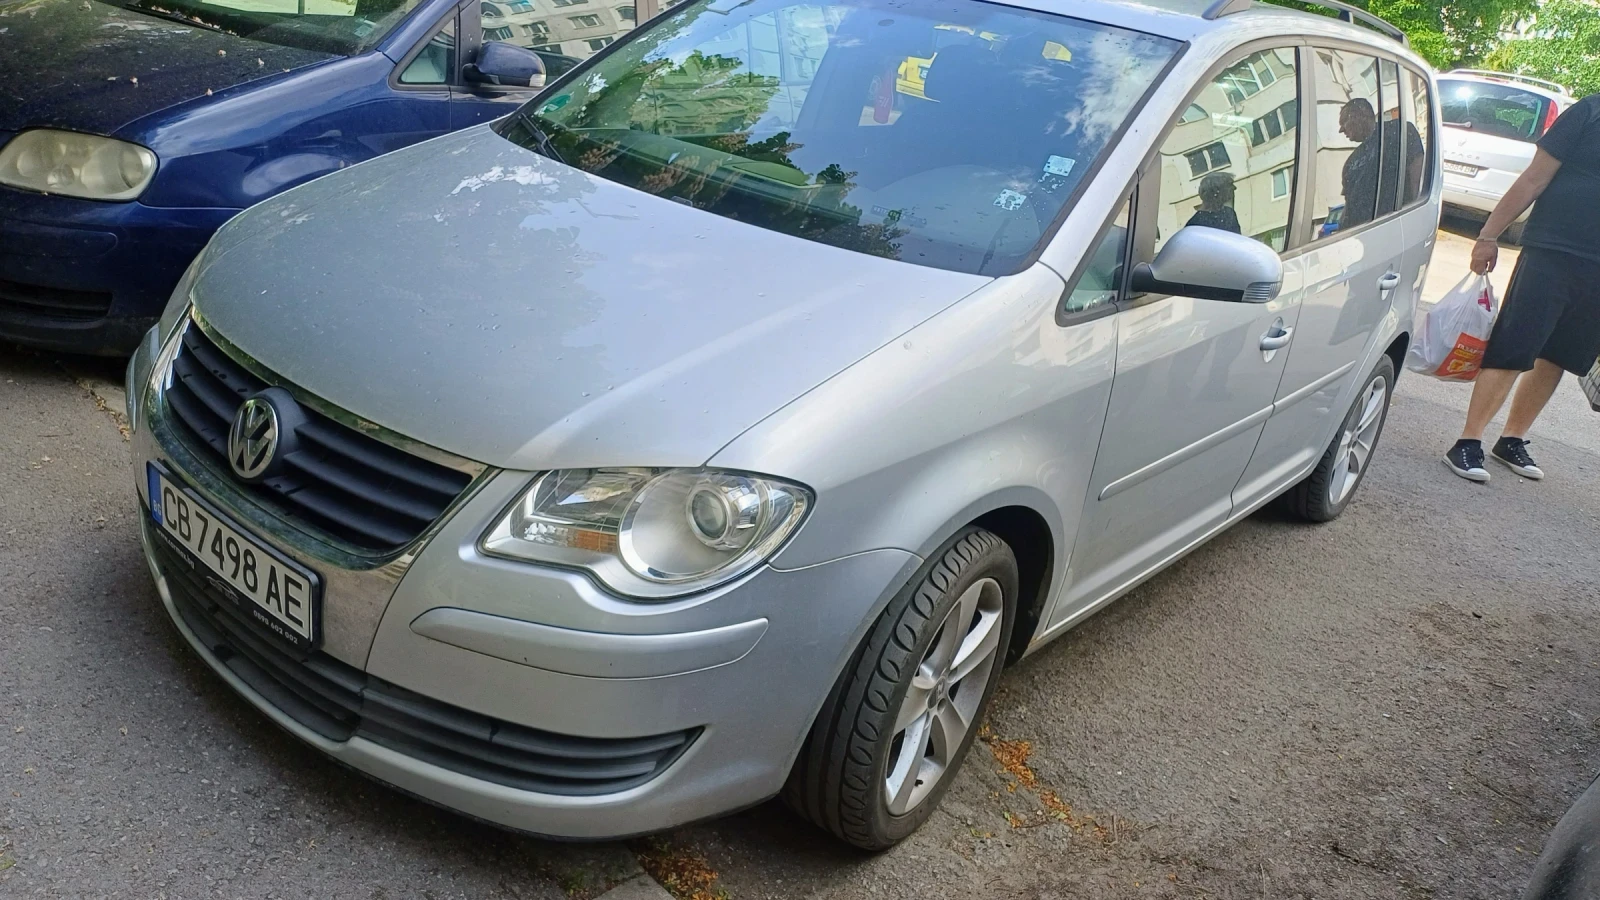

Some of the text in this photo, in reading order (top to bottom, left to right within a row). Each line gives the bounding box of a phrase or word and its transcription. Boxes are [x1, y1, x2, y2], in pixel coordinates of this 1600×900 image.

[164, 486, 191, 542] CB
[195, 509, 258, 593] 7498
[265, 564, 304, 628] AE
